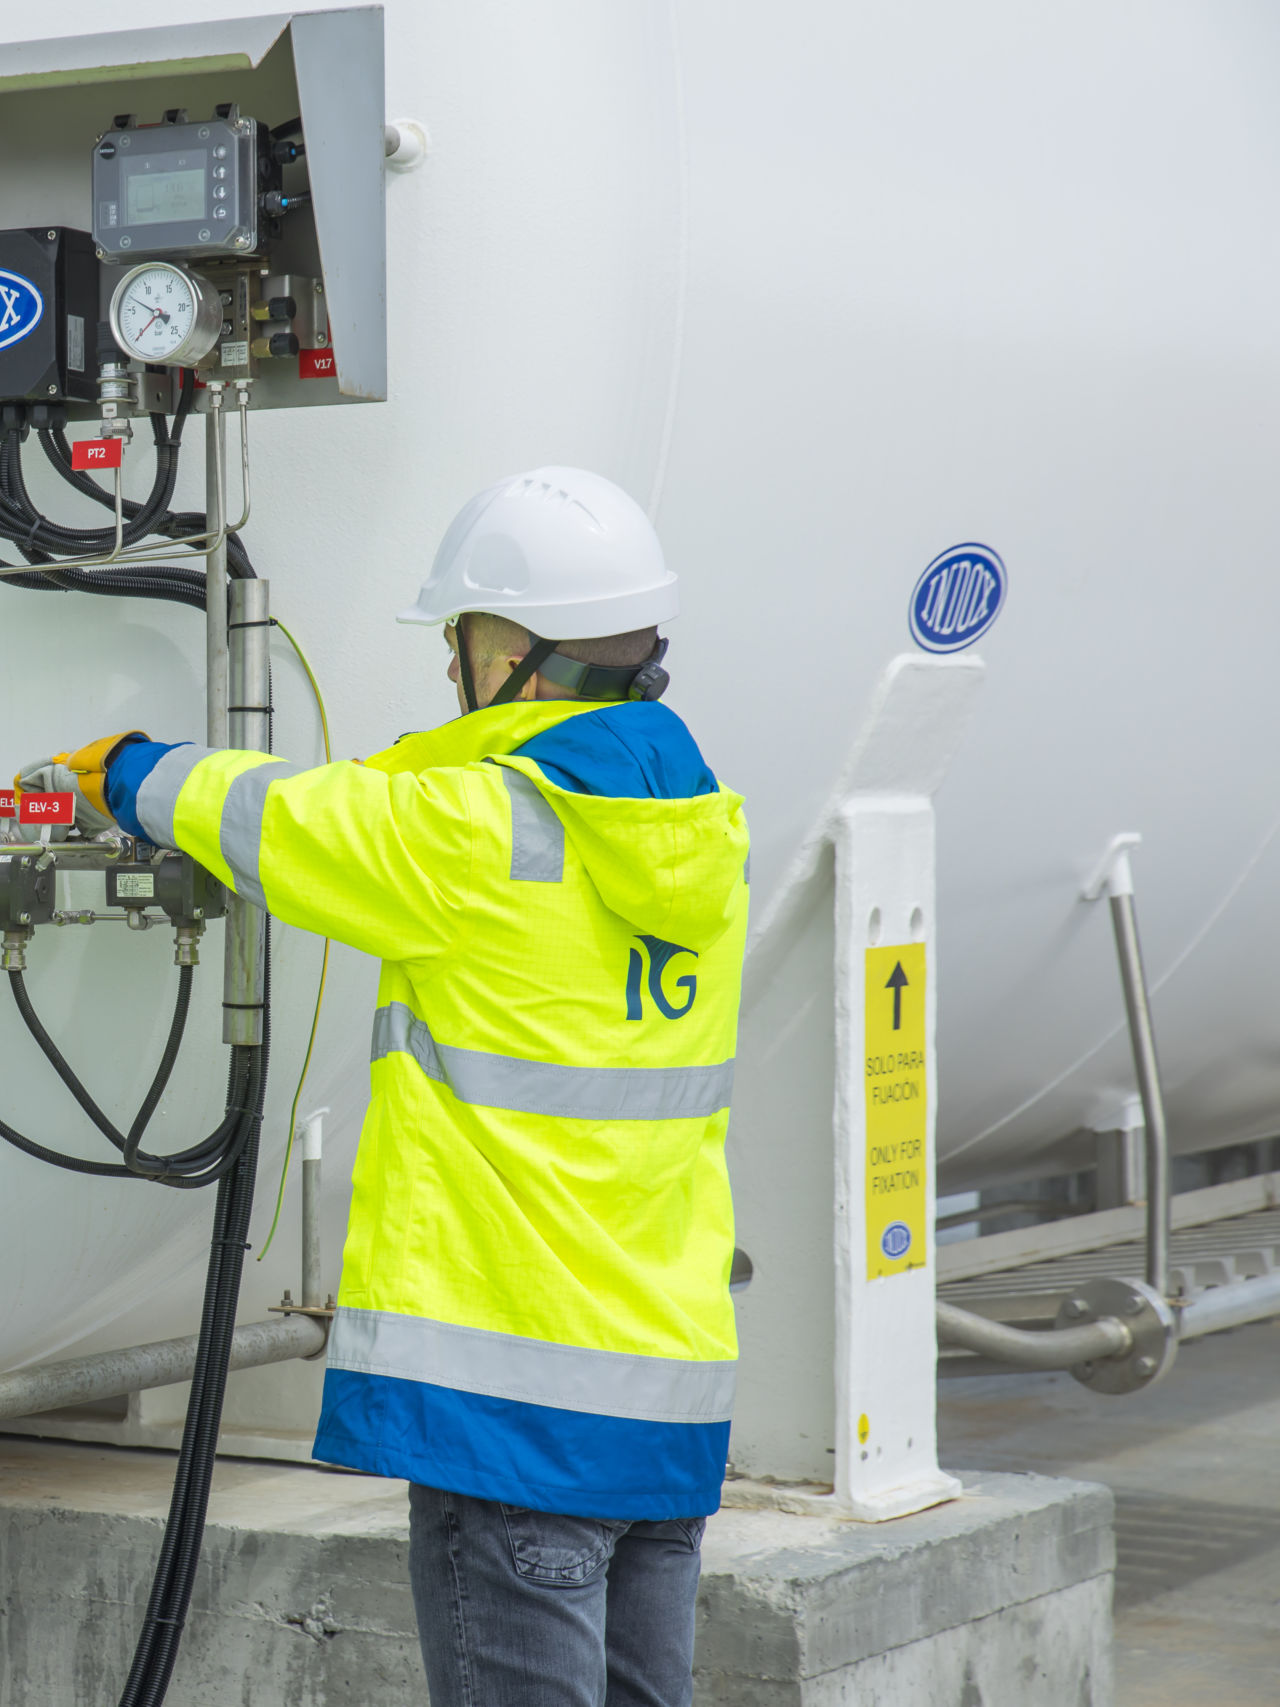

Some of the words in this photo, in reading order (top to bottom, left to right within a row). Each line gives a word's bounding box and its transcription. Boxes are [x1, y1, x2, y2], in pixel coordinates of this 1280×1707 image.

[145, 286, 152, 295] 10
[166, 284, 173, 294] 15
[178, 303, 186, 312] 20
[170, 325, 179, 335] 25
[314, 358, 333, 369] V17
[87, 447, 106, 459] PT2
[920, 560, 997, 635] INDOX
[29, 801, 60, 813] ELV-3
[866, 1055, 895, 1077] SOLO
[897, 1050, 924, 1073] PARA
[871, 1144, 897, 1166] ONLY
[899, 1139, 921, 1161] FOR
[873, 1170, 919, 1195] FIXATION
